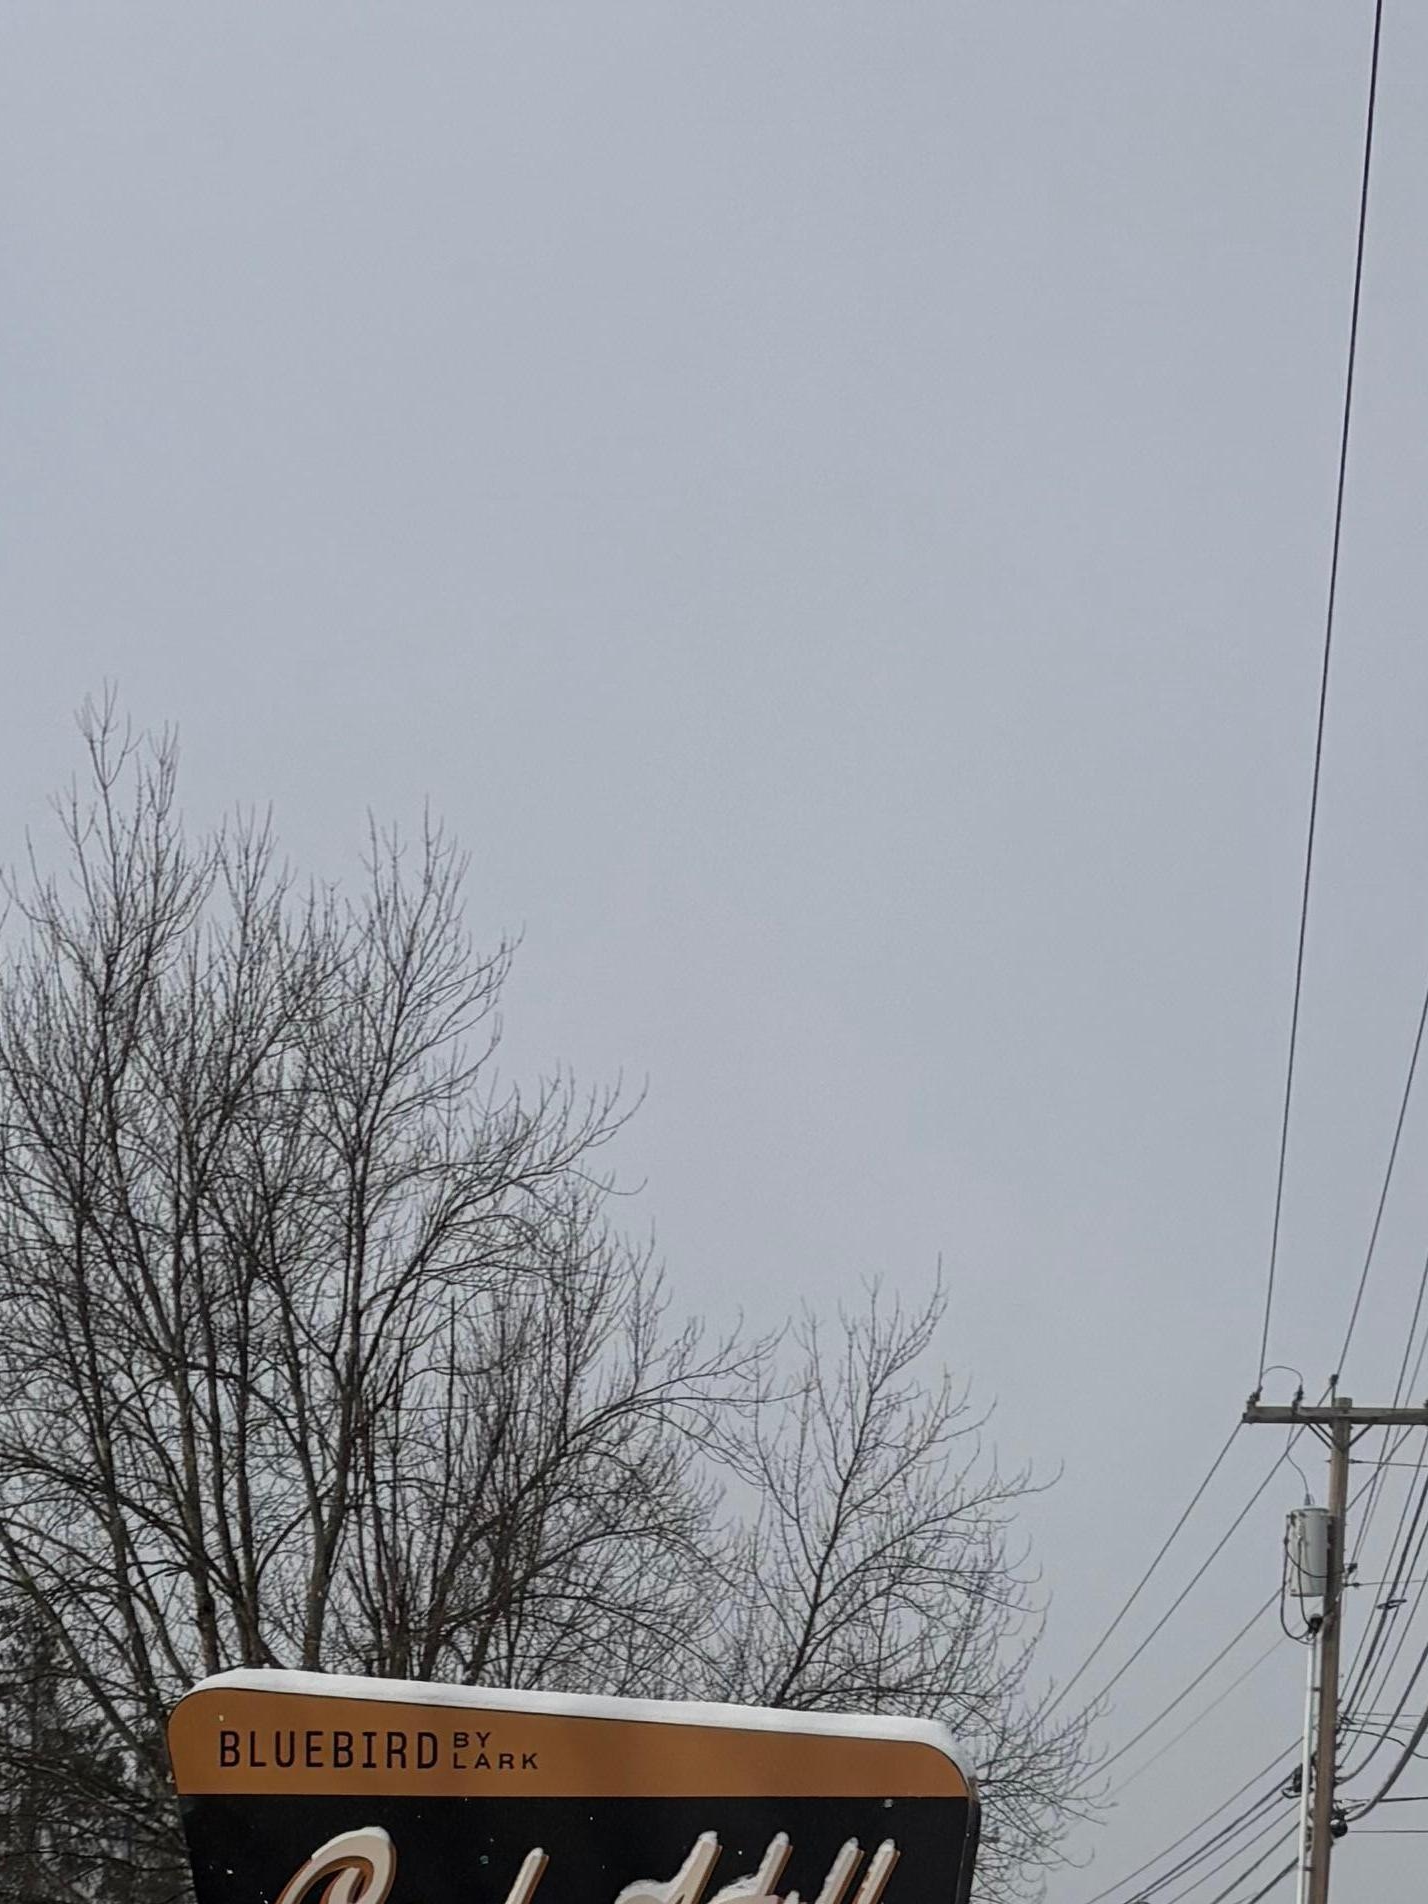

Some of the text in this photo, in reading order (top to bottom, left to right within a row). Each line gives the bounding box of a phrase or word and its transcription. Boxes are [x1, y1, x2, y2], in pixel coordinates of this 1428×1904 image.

[453, 1732, 491, 1748] BY
[220, 1731, 438, 1769] BLUEBIRD
[453, 1753, 538, 1770] LARK
